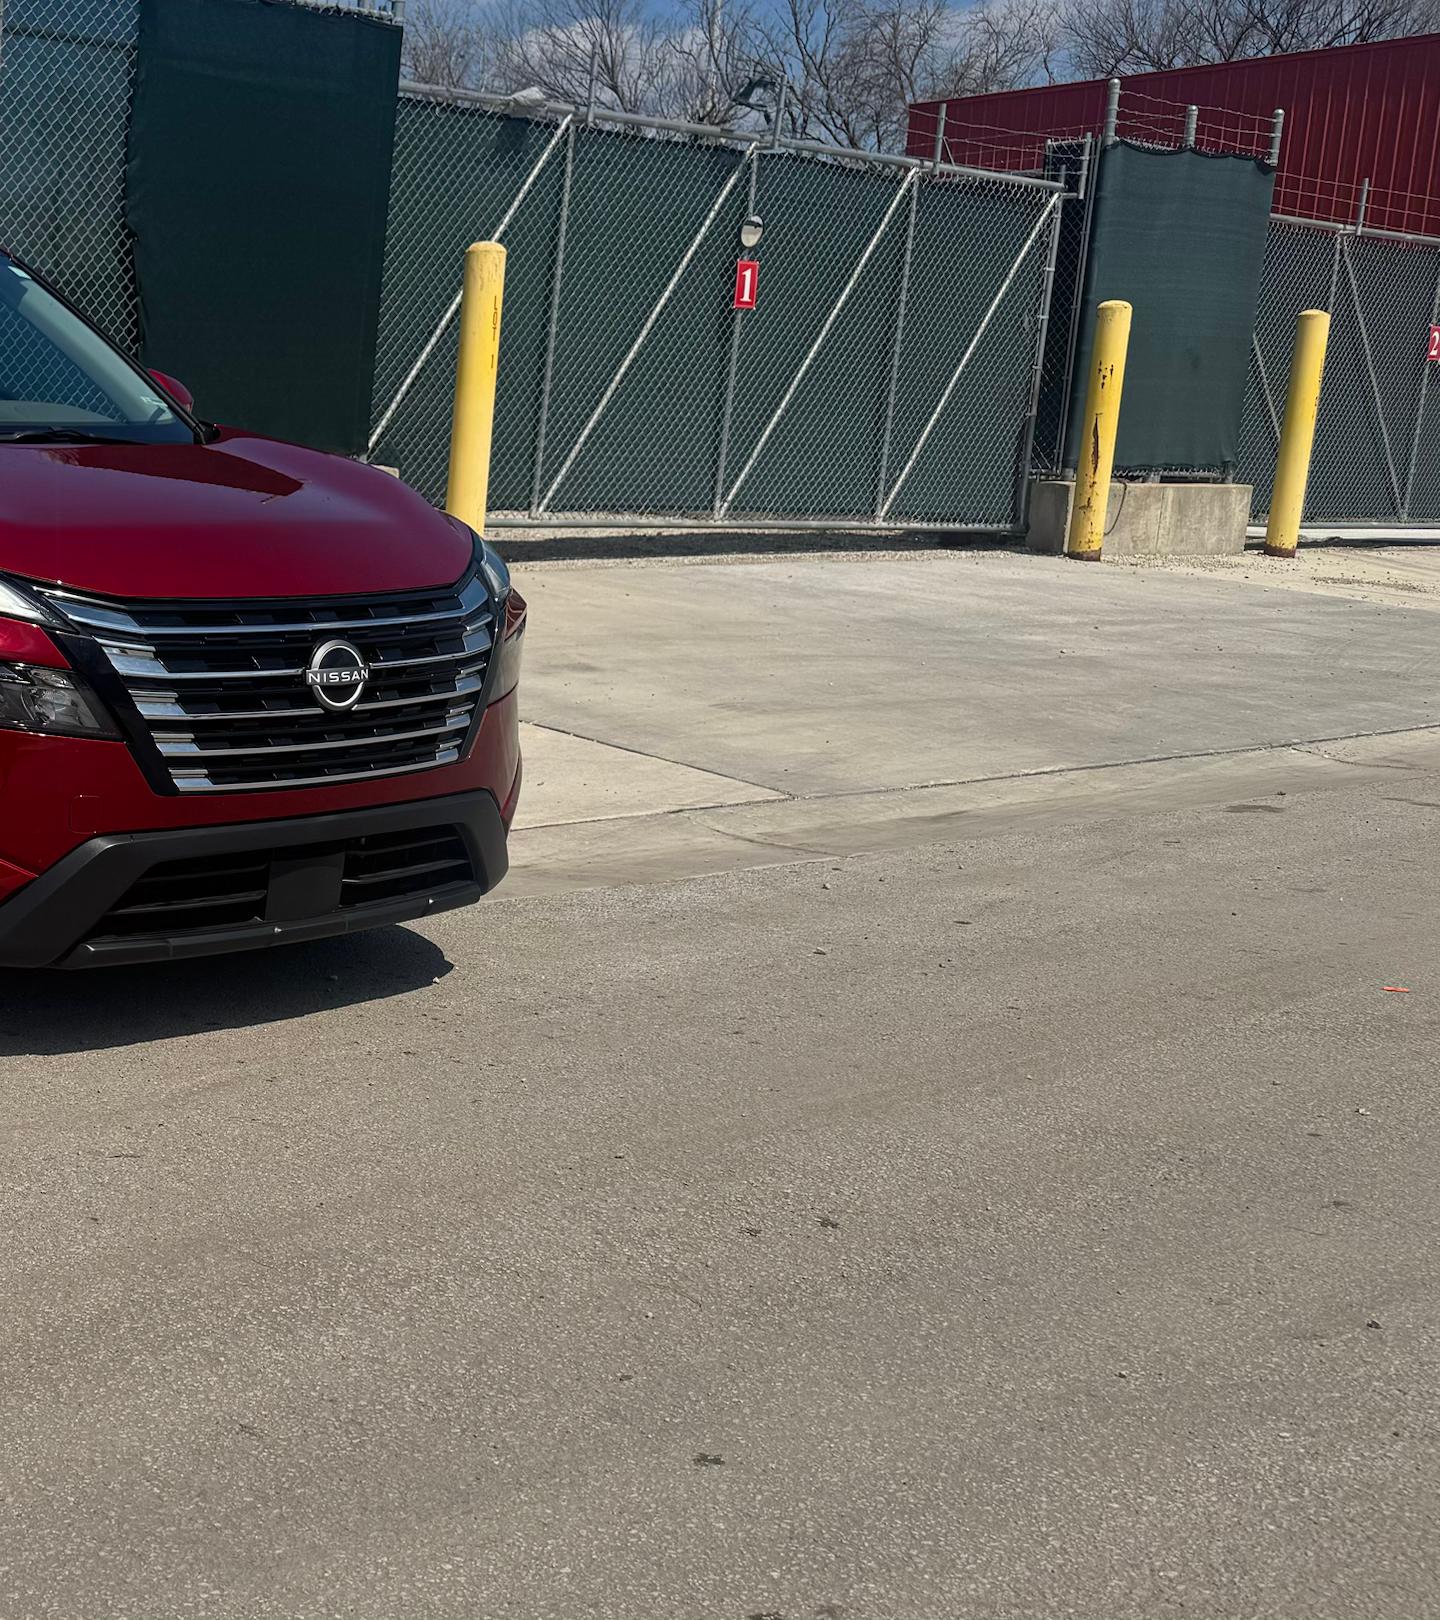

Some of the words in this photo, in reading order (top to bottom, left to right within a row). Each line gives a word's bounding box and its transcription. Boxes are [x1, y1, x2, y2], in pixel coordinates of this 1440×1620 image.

[740, 268, 752, 302] 1
[1430, 331, 1440, 356] 2
[308, 668, 369, 682] NISSAN
